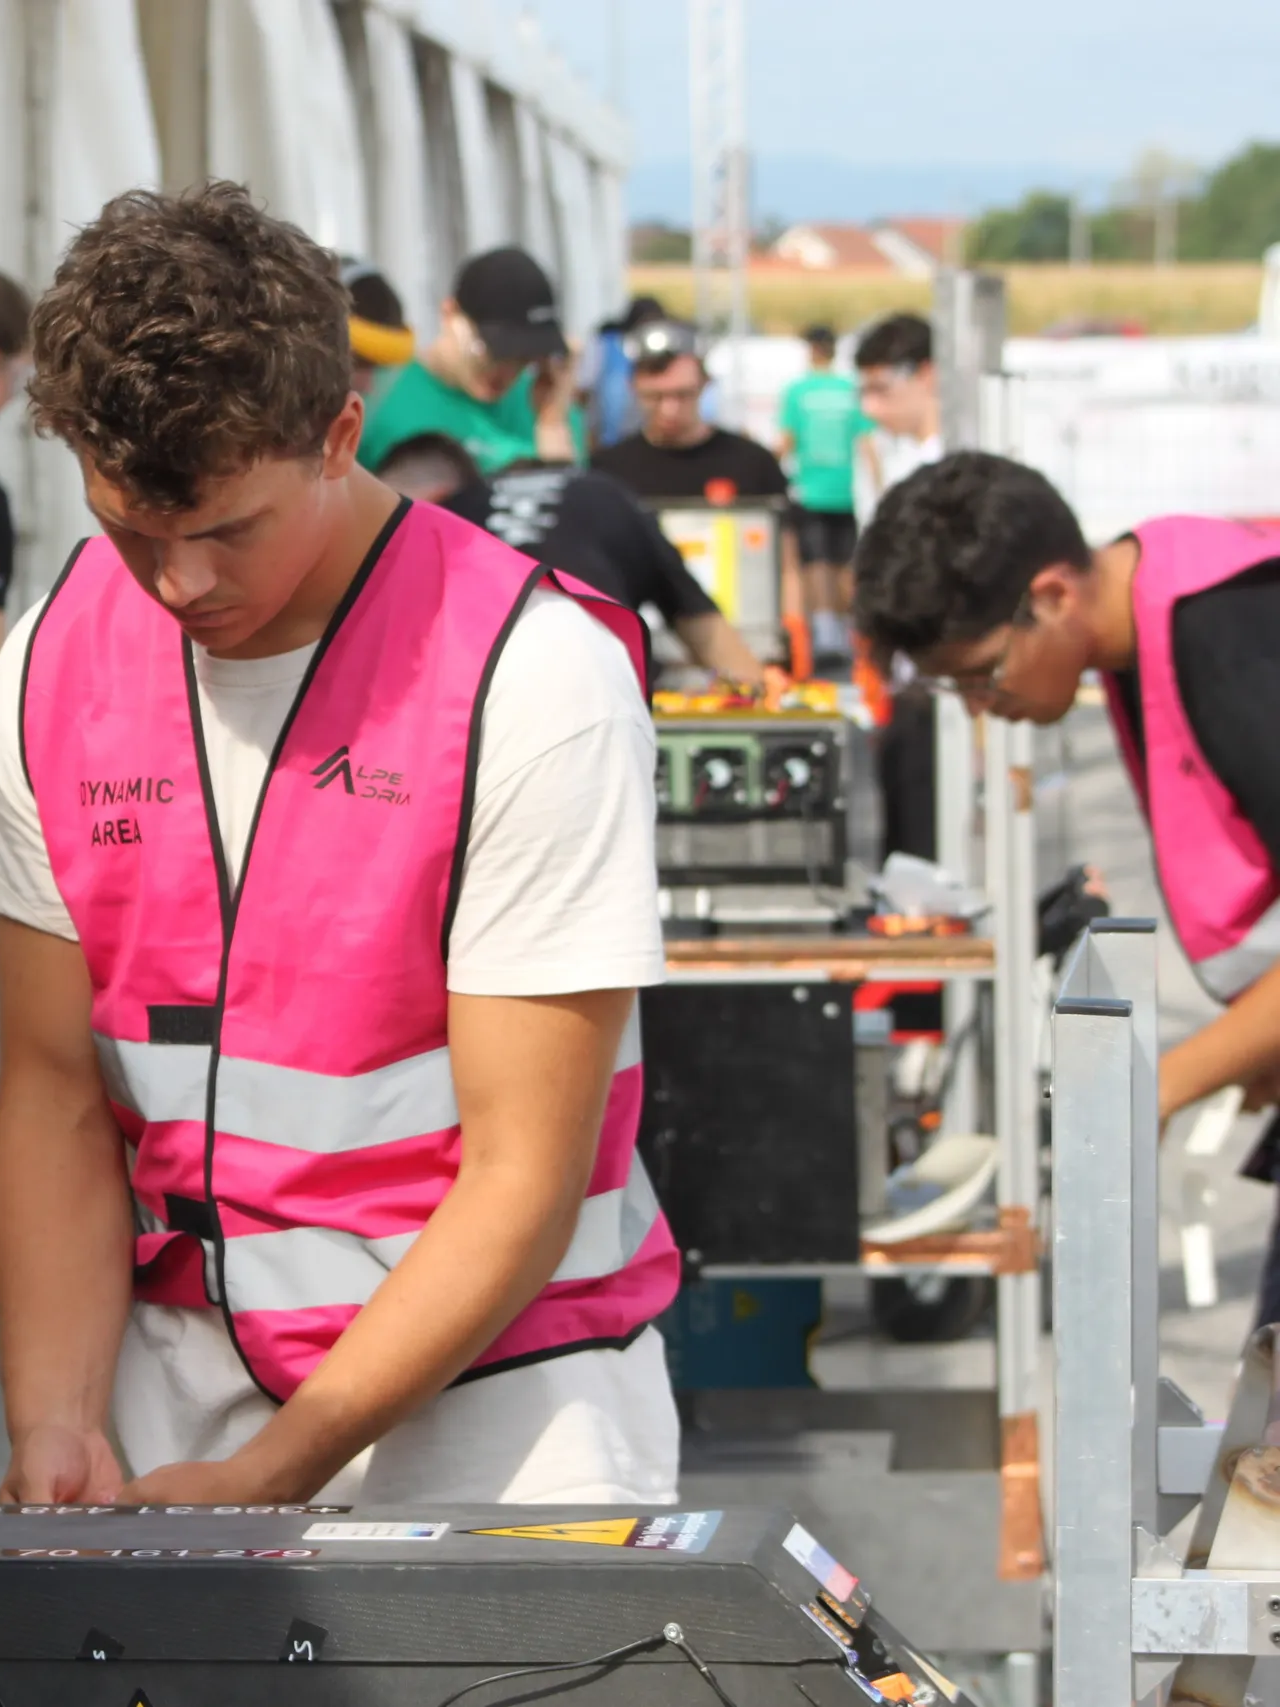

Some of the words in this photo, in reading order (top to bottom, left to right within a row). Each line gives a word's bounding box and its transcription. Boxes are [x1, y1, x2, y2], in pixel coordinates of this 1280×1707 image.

[80, 777, 174, 806] DYNAMIC
[91, 818, 142, 847] AREA
[19, 1549, 79, 1557] 70
[104, 1549, 190, 1558] 161
[212, 1549, 313, 1558] 279
